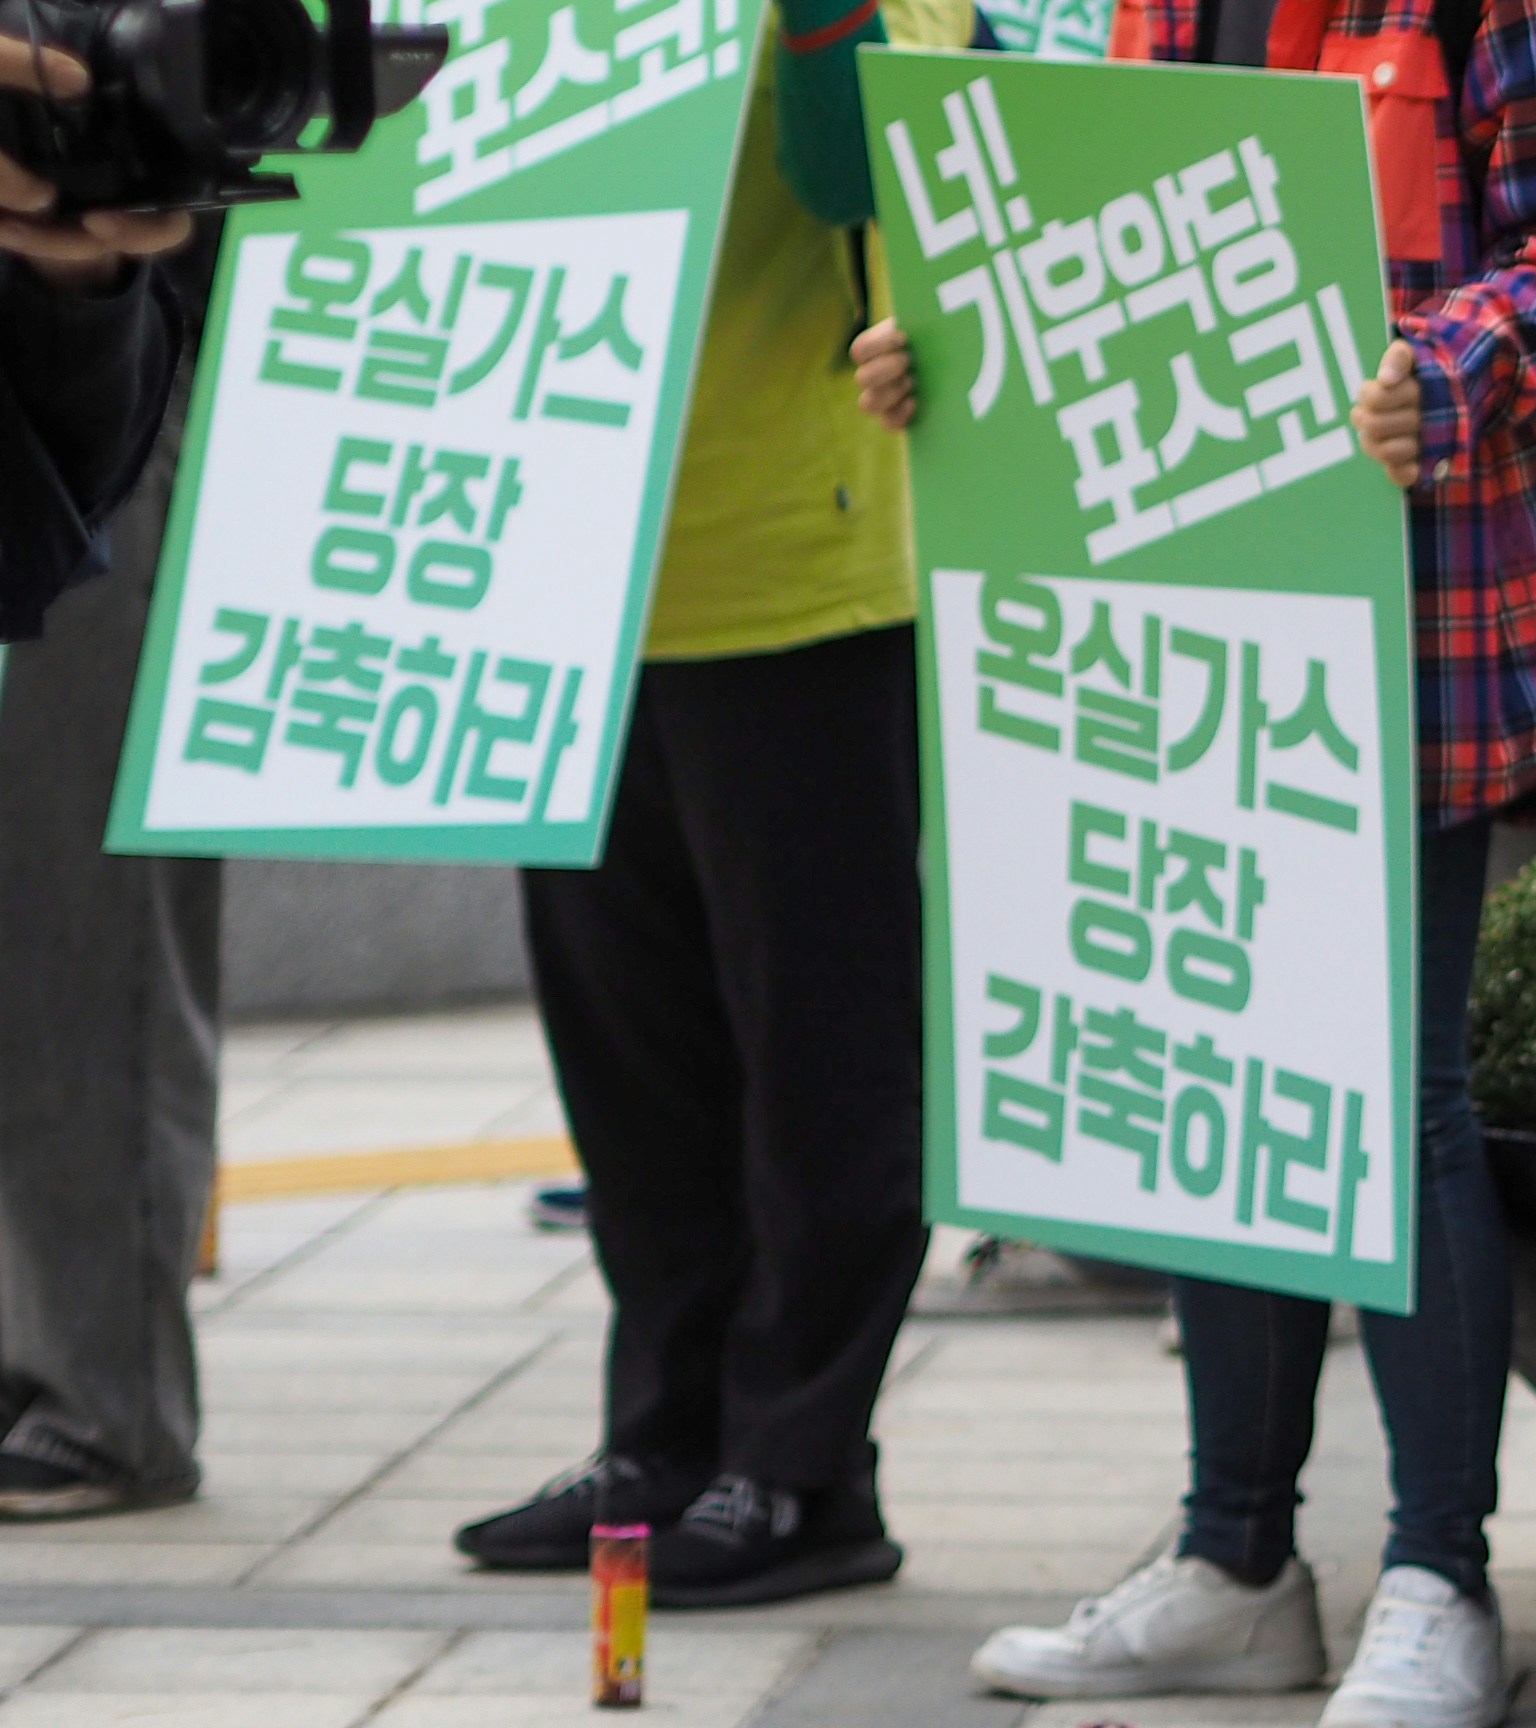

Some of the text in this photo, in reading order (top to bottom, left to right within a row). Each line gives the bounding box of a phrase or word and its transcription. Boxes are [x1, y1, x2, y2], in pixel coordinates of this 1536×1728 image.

[886, 75, 1033, 260] 너!
[258, 233, 644, 428] 온실가스
[936, 134, 1298, 420] 기후악당
[311, 436, 523, 611] 당장
[1056, 282, 1366, 565] 포스코!
[181, 606, 586, 822] 감축하라
[976, 575, 1360, 834] 온실가스
[1068, 798, 1266, 1015] 당장
[981, 970, 1370, 1257] 감축하라
